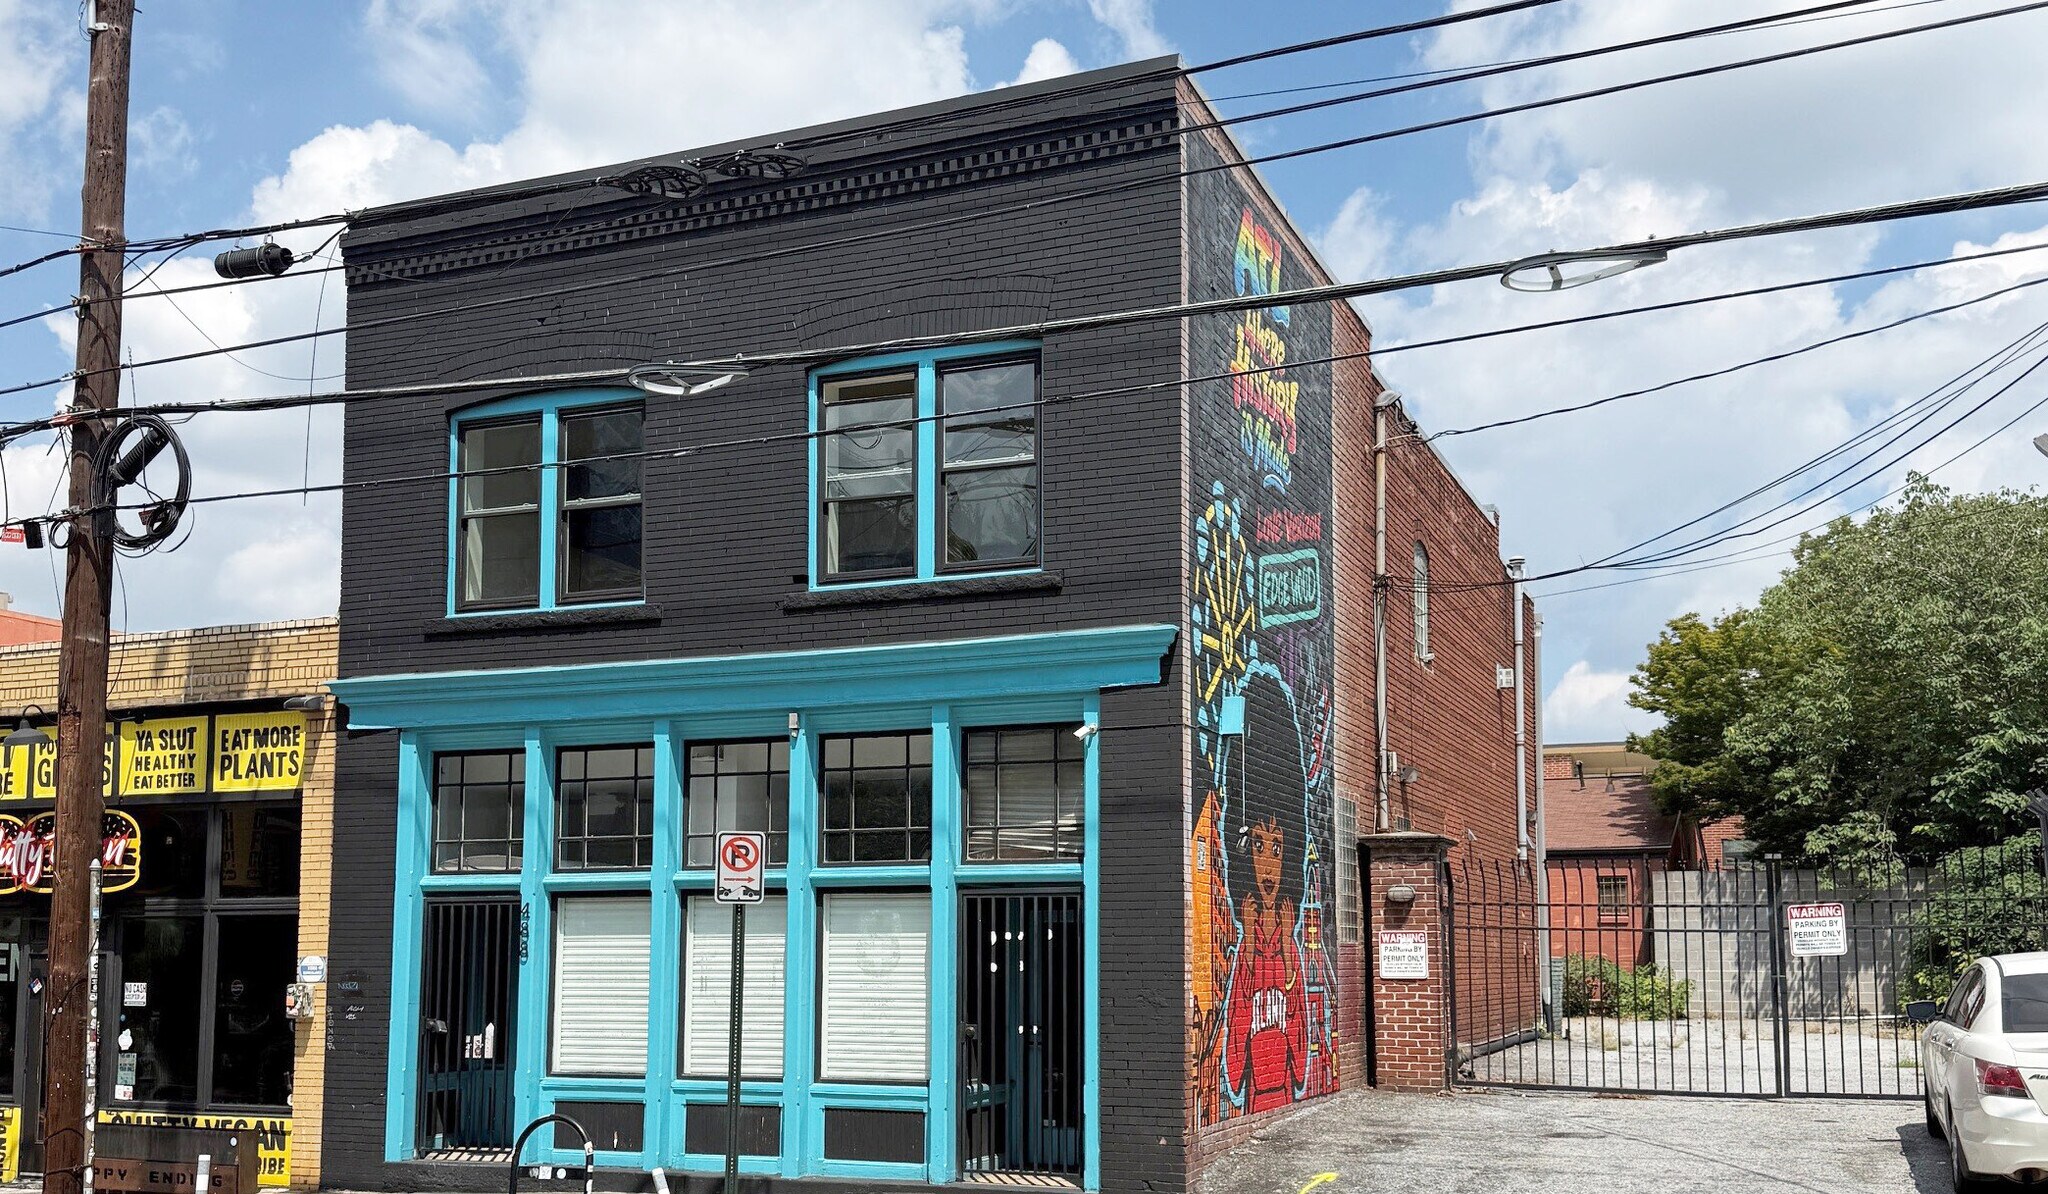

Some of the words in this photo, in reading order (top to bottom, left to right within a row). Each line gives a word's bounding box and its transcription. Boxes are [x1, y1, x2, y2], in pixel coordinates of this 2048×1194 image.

[1234, 207, 1290, 328] ATL
[135, 730, 154, 751] YA
[159, 726, 197, 751] SLUT
[221, 729, 251, 752] EAT
[253, 725, 301, 749] MORE
[135, 753, 196, 772] HEALTHY
[220, 750, 299, 782] PLANTS
[133, 776, 153, 789] EAT
[156, 772, 195, 788] BETTER
[1790, 906, 1842, 918] WARNING
[1795, 920, 1827, 928] PARKING
[1828, 919, 1838, 927] BY
[1793, 930, 1820, 938] PERMIT
[1821, 930, 1841, 938] ONLY
[1413, 945, 1422, 953] BY
[149, 1171, 222, 1188] ENDIG
